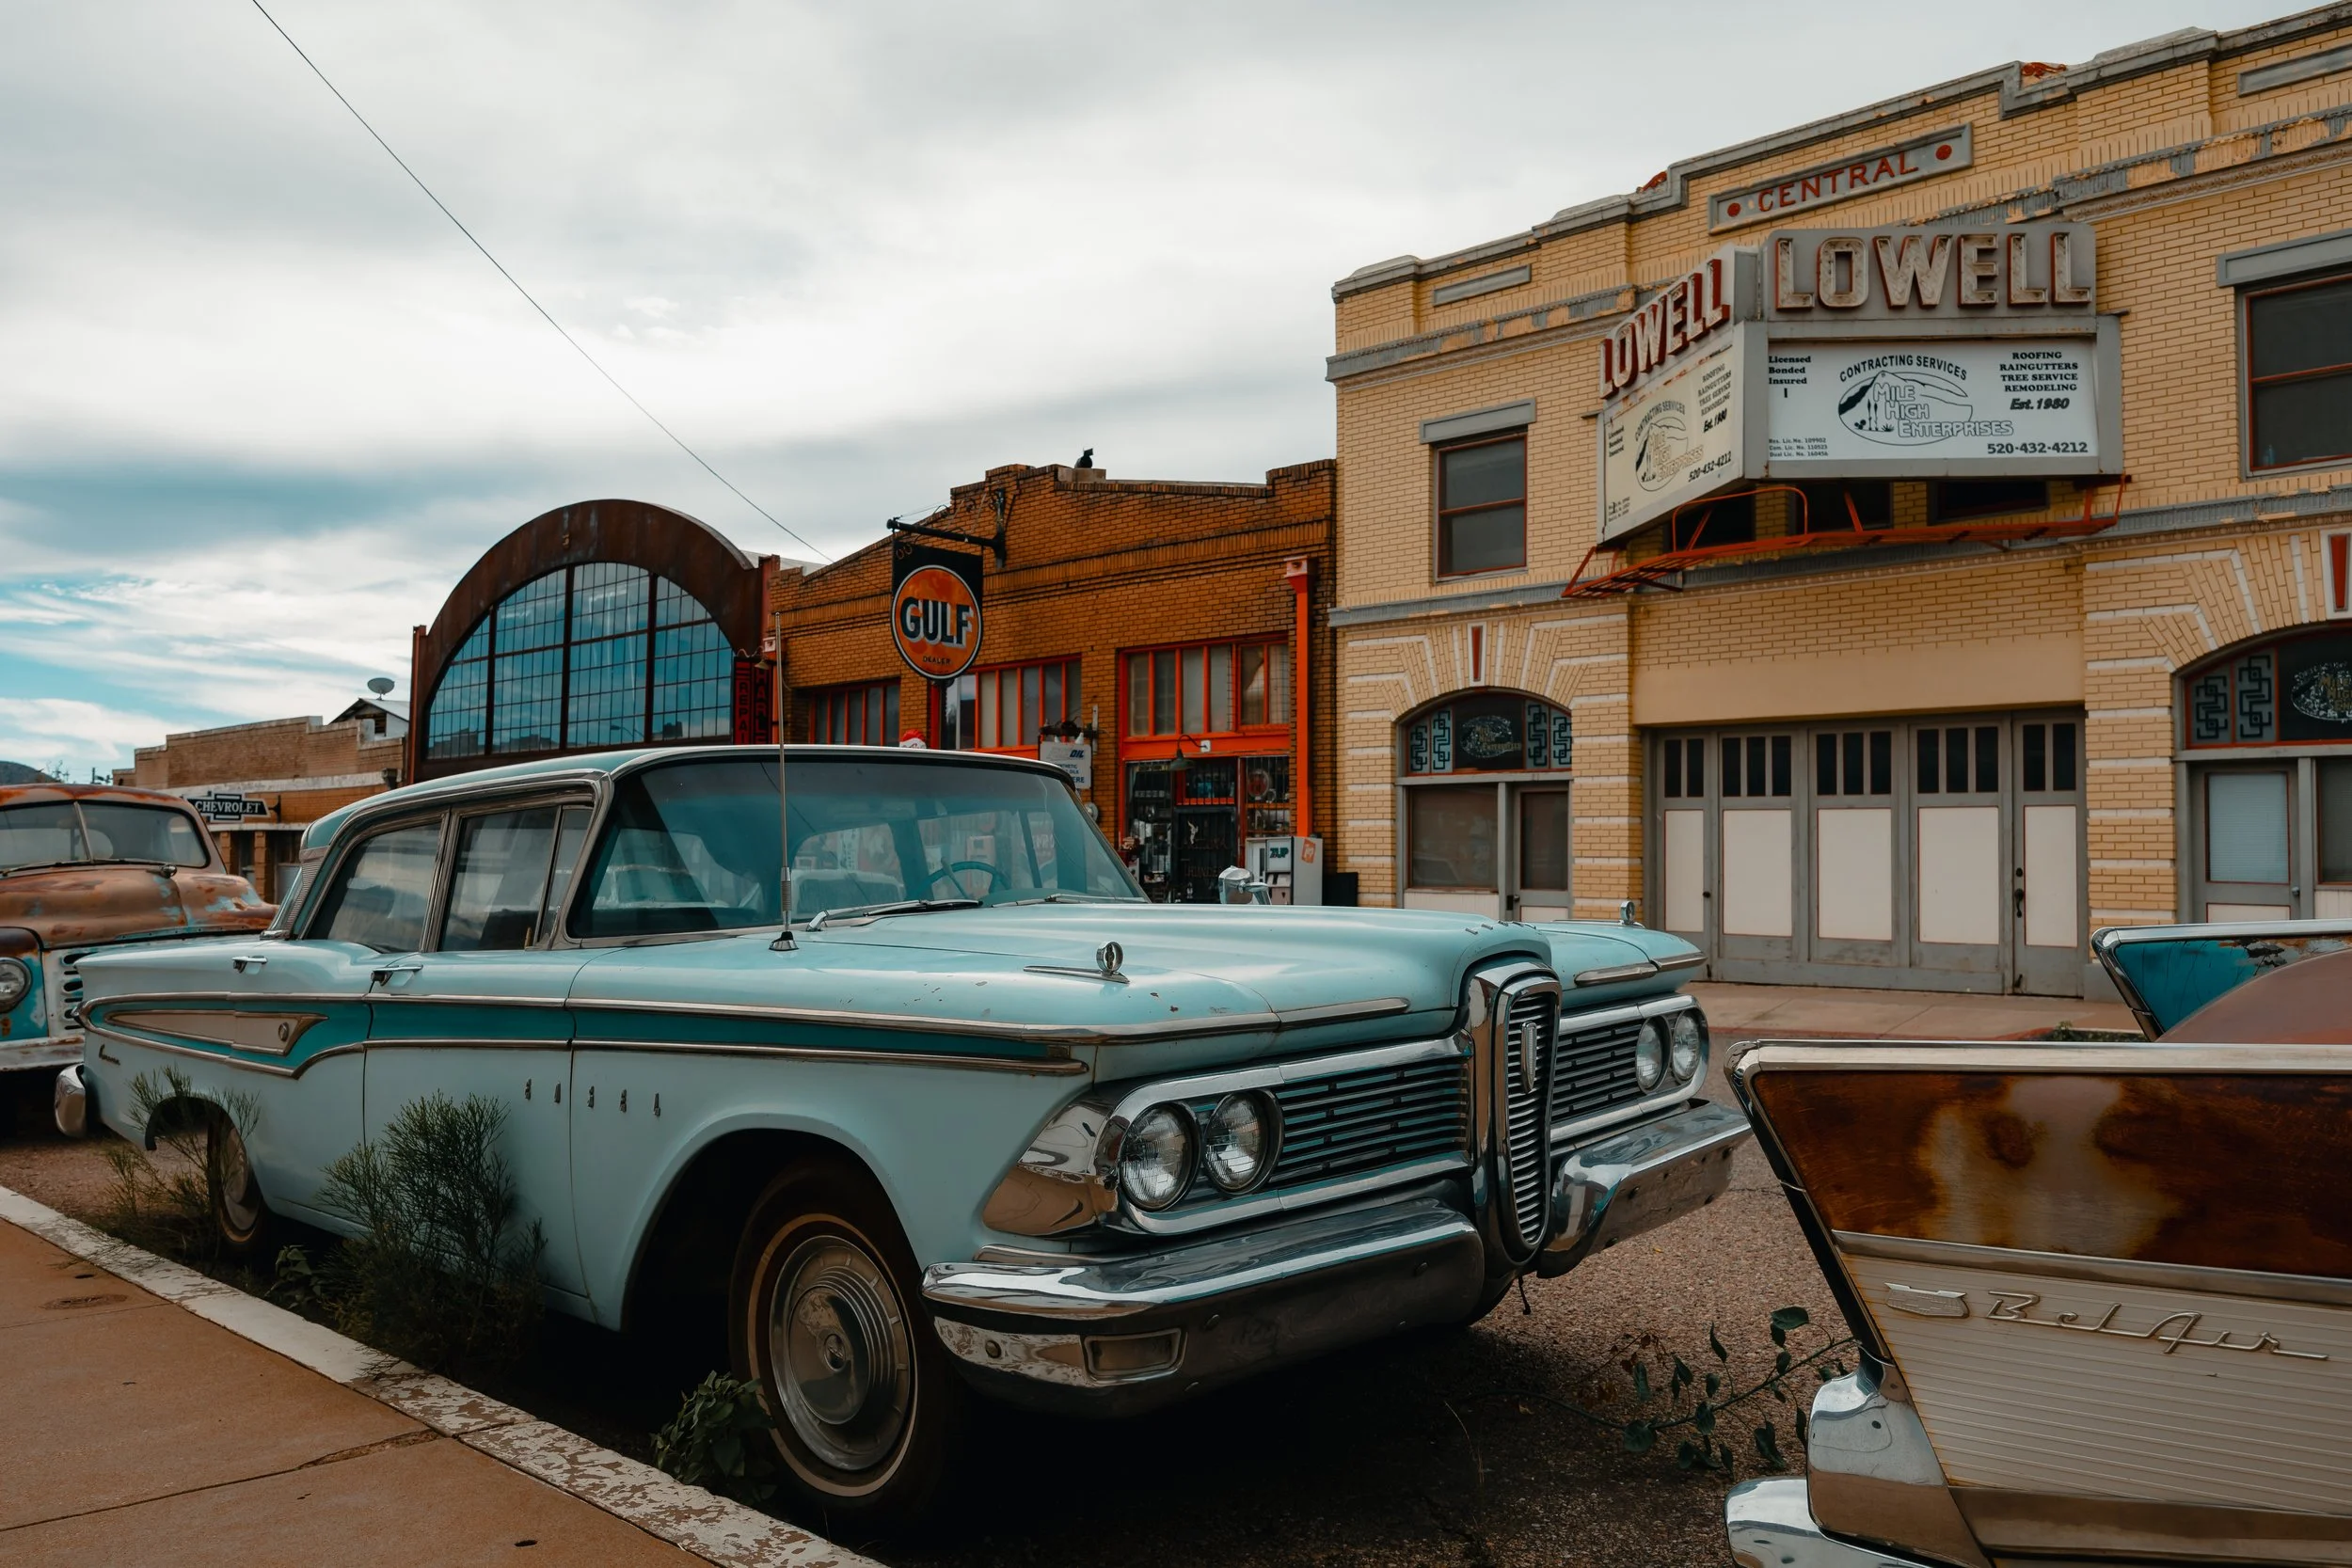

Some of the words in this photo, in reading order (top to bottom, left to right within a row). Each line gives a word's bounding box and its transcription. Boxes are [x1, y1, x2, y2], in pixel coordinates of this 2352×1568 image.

[1757, 151, 1919, 212] CENTRAL
[1775, 232, 2092, 311] LOWELL
[1599, 259, 1730, 399] LOWELL
[2011, 351, 2063, 359] ROOFING
[1702, 363, 1725, 383] ROOFING
[1839, 355, 1914, 383] CONTRACTING
[1915, 355, 1967, 381] SERVICES
[1998, 362, 2079, 372] RAINGUTTERS
[1697, 370, 1732, 398] RAINGUTTERS
[2031, 373, 2079, 382] SERVICE
[1699, 393, 1712, 406] TREE
[1712, 381, 1731, 401] SERVICE
[1872, 382, 1915, 403] MILE
[2004, 384, 2078, 392] REMODELING
[1662, 400, 1686, 416] SERVICES
[1701, 391, 1731, 417] REMODELING
[1884, 400, 1931, 420] HIGH
[1897, 419, 2014, 438] ENTERPRISES
[900, 595, 974, 650] GULF
[922, 655, 951, 666] DEALER
[194, 800, 262, 814] CHEVROLET
[1985, 1290, 2150, 1338] Bel
[2148, 1310, 2329, 1362] Air
